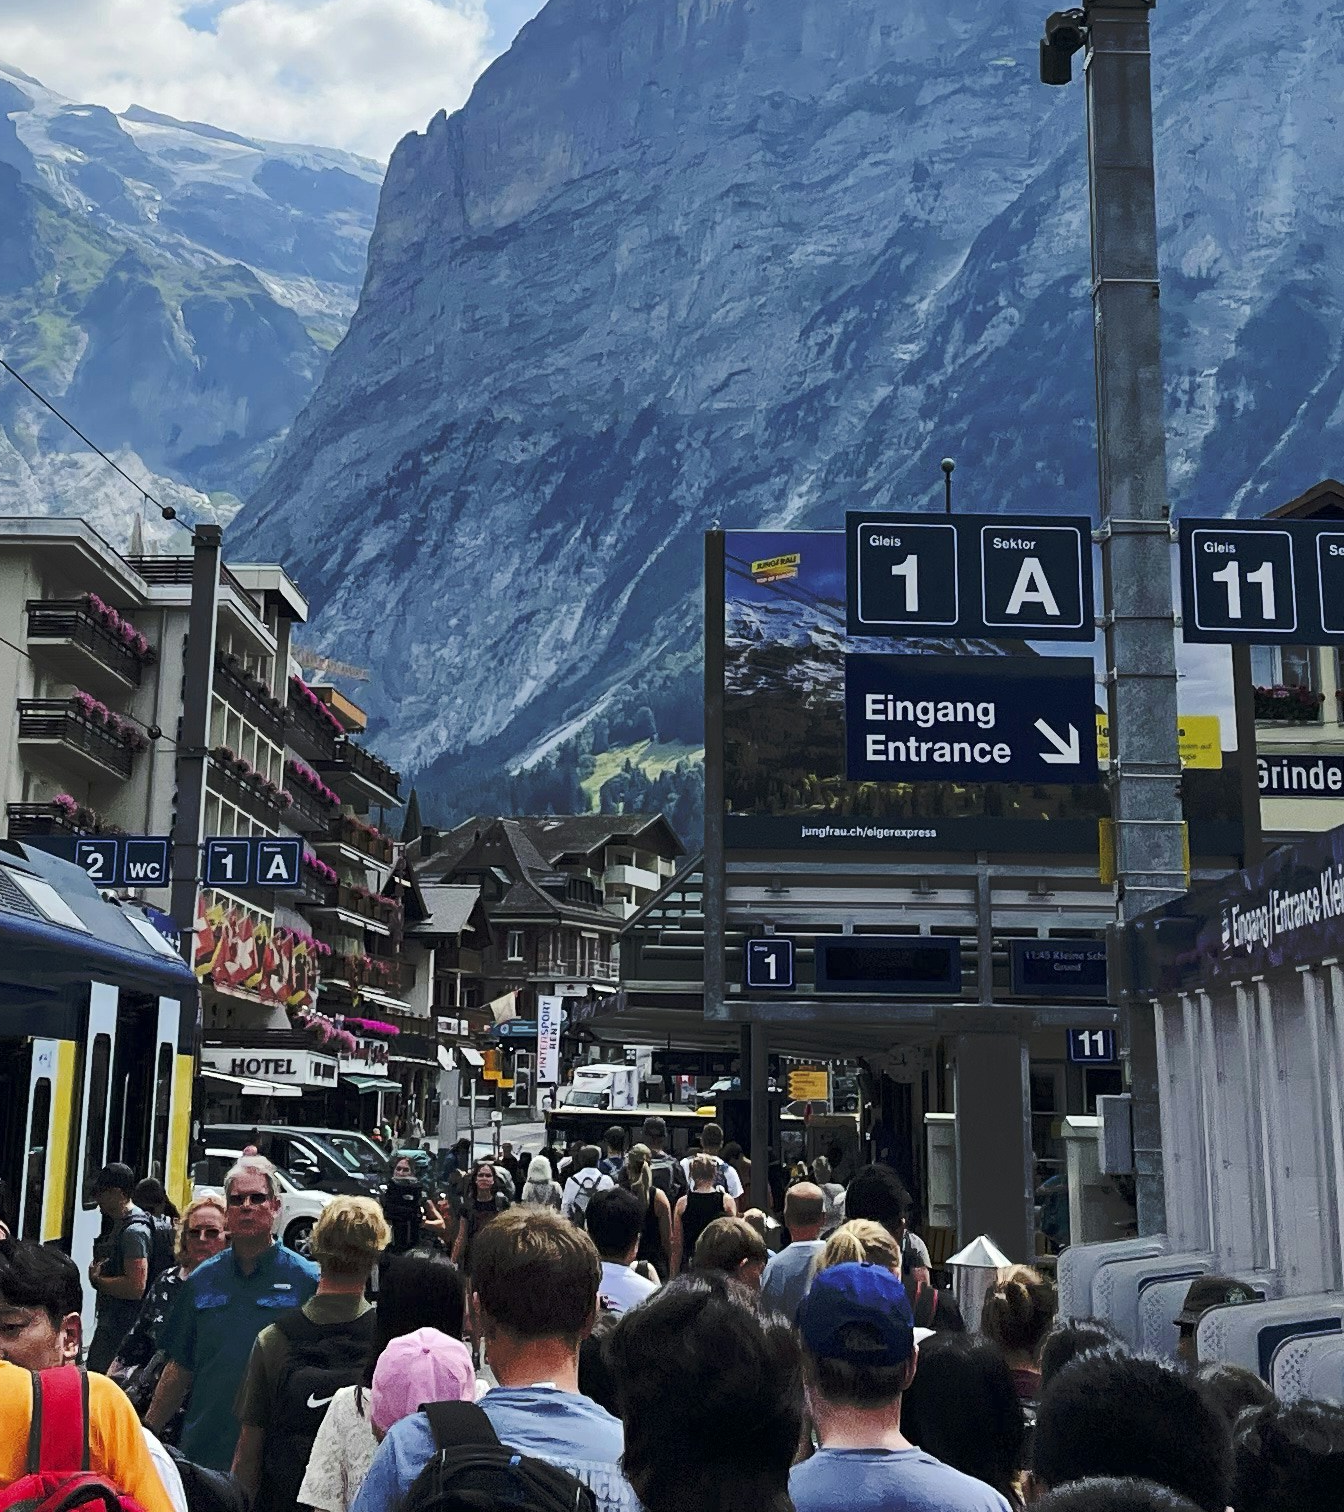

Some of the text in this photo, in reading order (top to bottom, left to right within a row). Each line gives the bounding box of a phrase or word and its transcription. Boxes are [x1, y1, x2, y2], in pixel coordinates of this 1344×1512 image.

[869, 534, 902, 547] Gleis
[993, 537, 1037, 550] Sektor
[1204, 541, 1236, 554] Gleis
[891, 554, 919, 612] 1
[1005, 557, 1061, 616] A
[1212, 560, 1276, 620] 11
[865, 693, 996, 729] Eingang
[866, 734, 1012, 764] Entrance
[801, 825, 937, 839] jungfrau.ch/eigerexpress
[86, 852, 104, 878] 2
[129, 862, 161, 879] WC
[221, 854, 234, 879] 1
[266, 854, 289, 880] A
[764, 953, 777, 980] 1
[539, 1000, 552, 1069] INTERSPORT
[1078, 1030, 1104, 1056] 11
[232, 1058, 297, 1075] HOTEL
